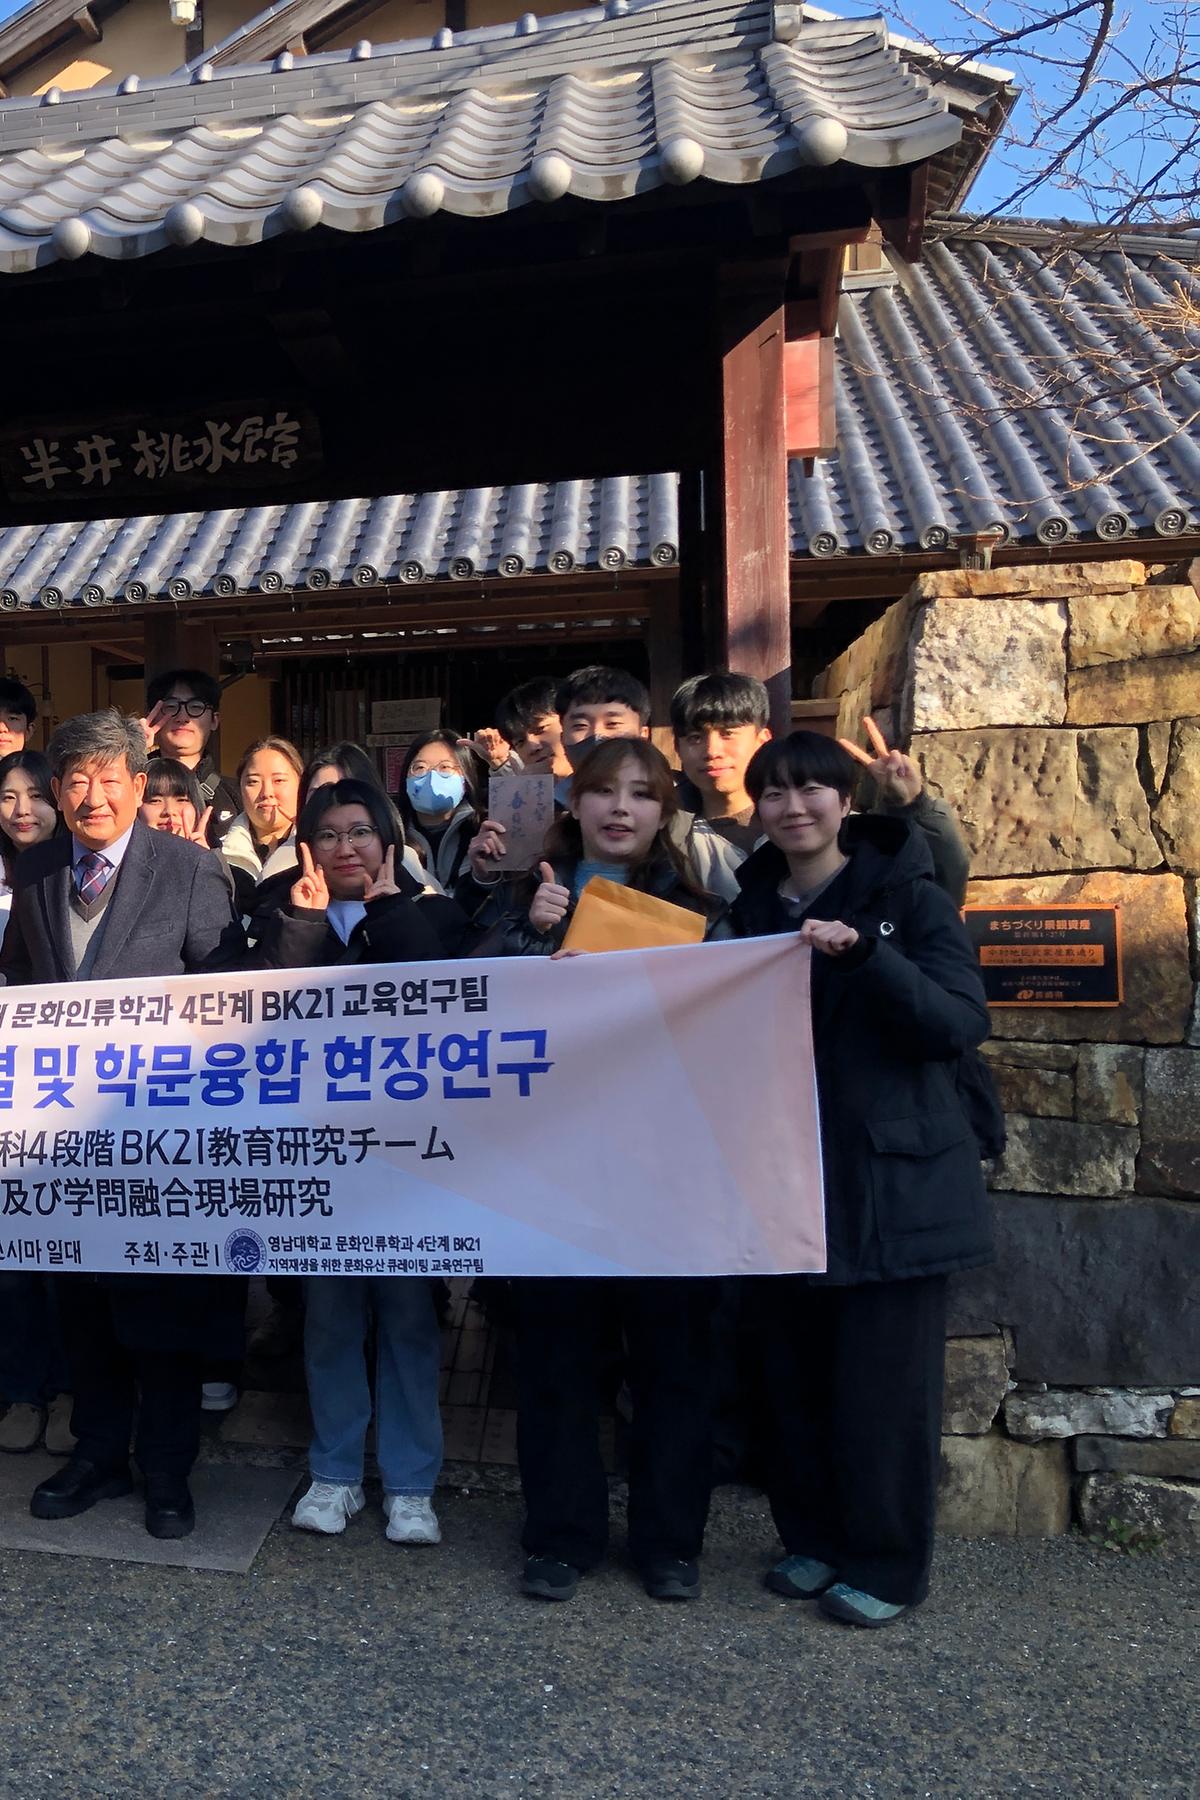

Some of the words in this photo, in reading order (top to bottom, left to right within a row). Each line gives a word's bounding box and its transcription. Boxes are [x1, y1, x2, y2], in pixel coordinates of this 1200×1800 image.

[11, 994, 173, 1029] 문화인류학과
[180, 989, 254, 1026] 4단계
[261, 987, 335, 1021] BK21
[343, 975, 490, 1017] 교육연구팀
[34, 1045, 80, 1108] 및
[95, 1037, 309, 1106] 학문융합
[323, 1030, 555, 1102] 현장연구
[46, 1240, 82, 1264] 일대
[123, 1241, 210, 1268] 주최·주관
[267, 1234, 332, 1253] 영남대학교
[335, 1235, 415, 1253] 문화인류학과
[416, 1235, 449, 1253] 4단계
[453, 1237, 481, 1253] BK21
[268, 1257, 319, 1273] 지역재생을
[321, 1257, 342, 1273] 위한
[343, 1258, 386, 1273] 문화유산
[387, 1258, 429, 1273] 큐레이팅
[430, 1258, 485, 1274] 교육연구팀
